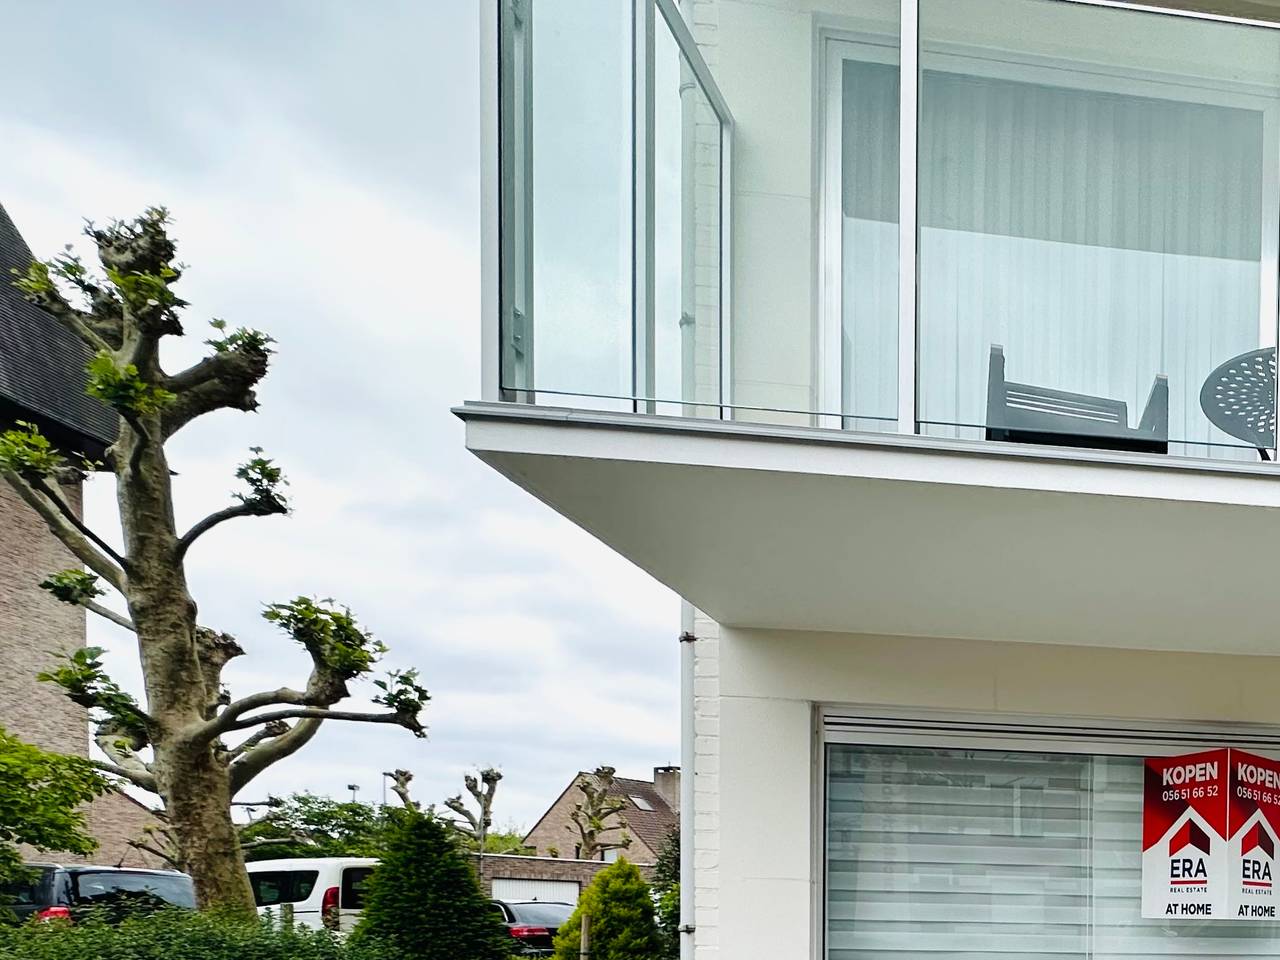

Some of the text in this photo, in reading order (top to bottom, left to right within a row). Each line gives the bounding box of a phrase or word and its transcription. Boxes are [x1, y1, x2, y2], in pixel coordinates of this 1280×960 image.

[1162, 761, 1218, 786] KOPEN
[1162, 785, 1219, 801] 056 51 66 52
[1236, 786, 1253, 800] 056
[1253, 789, 1261, 801] 51
[1262, 791, 1272, 804] 66
[1170, 858, 1208, 878] ERA
[1242, 859, 1272, 881] ERA
[1165, 903, 1212, 915] AT HOME
[1237, 904, 1276, 918] AT HOME
